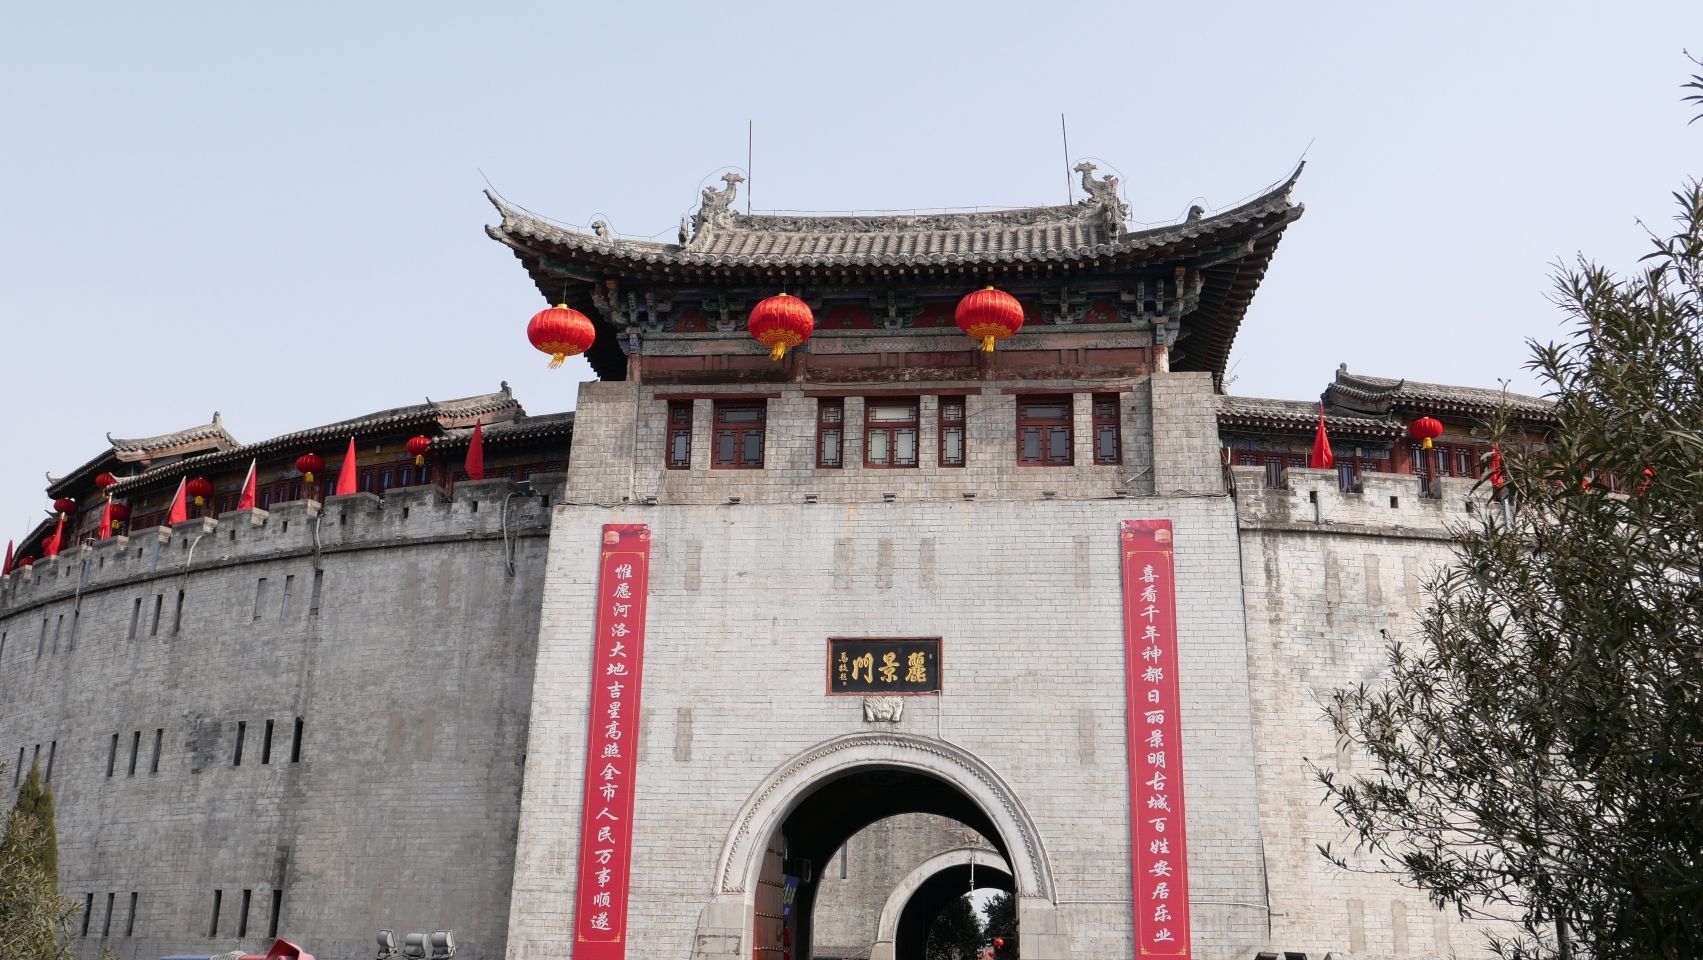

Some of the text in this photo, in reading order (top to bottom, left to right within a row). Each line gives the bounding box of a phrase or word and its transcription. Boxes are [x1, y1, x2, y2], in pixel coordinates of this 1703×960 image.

[1138, 565, 1175, 943] 喜看千年神都日丽景明古城百姓安居乐业
